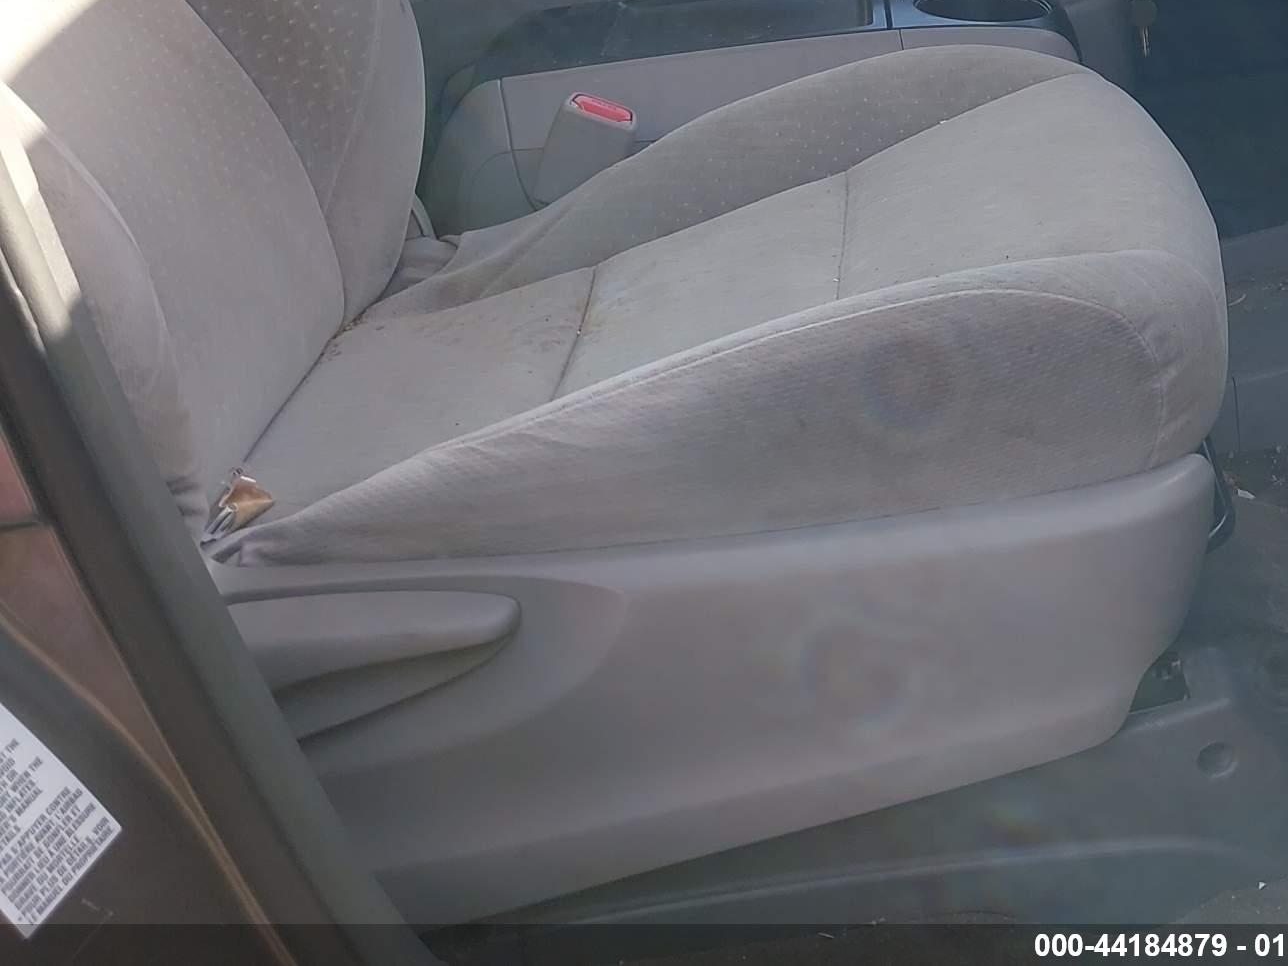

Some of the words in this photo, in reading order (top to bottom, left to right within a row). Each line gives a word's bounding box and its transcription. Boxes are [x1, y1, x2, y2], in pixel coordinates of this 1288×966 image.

[4, 778, 35, 813] INFLATES
[9, 769, 30, 793] WHEN
[14, 785, 42, 816] MANUAL
[44, 786, 70, 815] CONTRE
